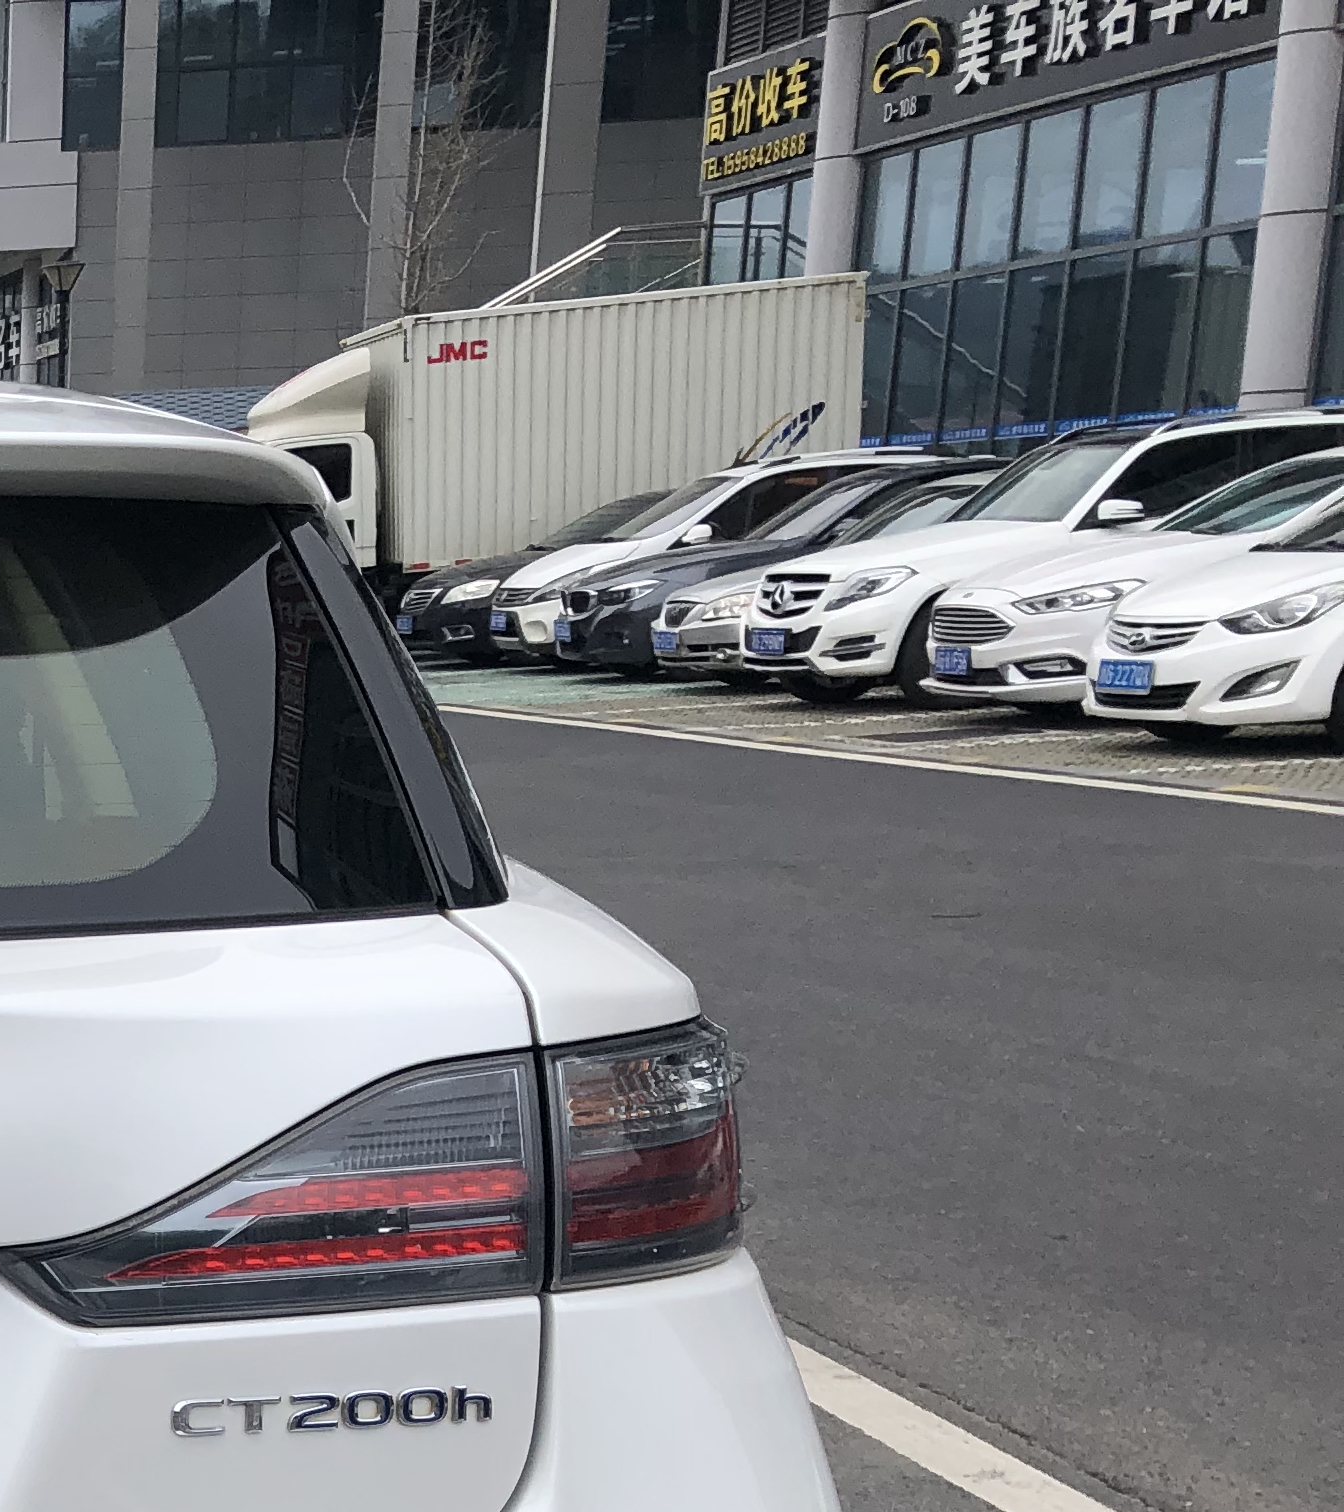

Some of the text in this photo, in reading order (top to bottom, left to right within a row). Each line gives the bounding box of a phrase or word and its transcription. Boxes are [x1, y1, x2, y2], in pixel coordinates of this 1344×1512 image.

[954, 0, 1251, 95] 美车族名
[707, 58, 809, 146] 高价收车
[883, 96, 917, 123] D-108
[427, 340, 488, 364] JMC
[170, 1384, 493, 1437] CT200h
